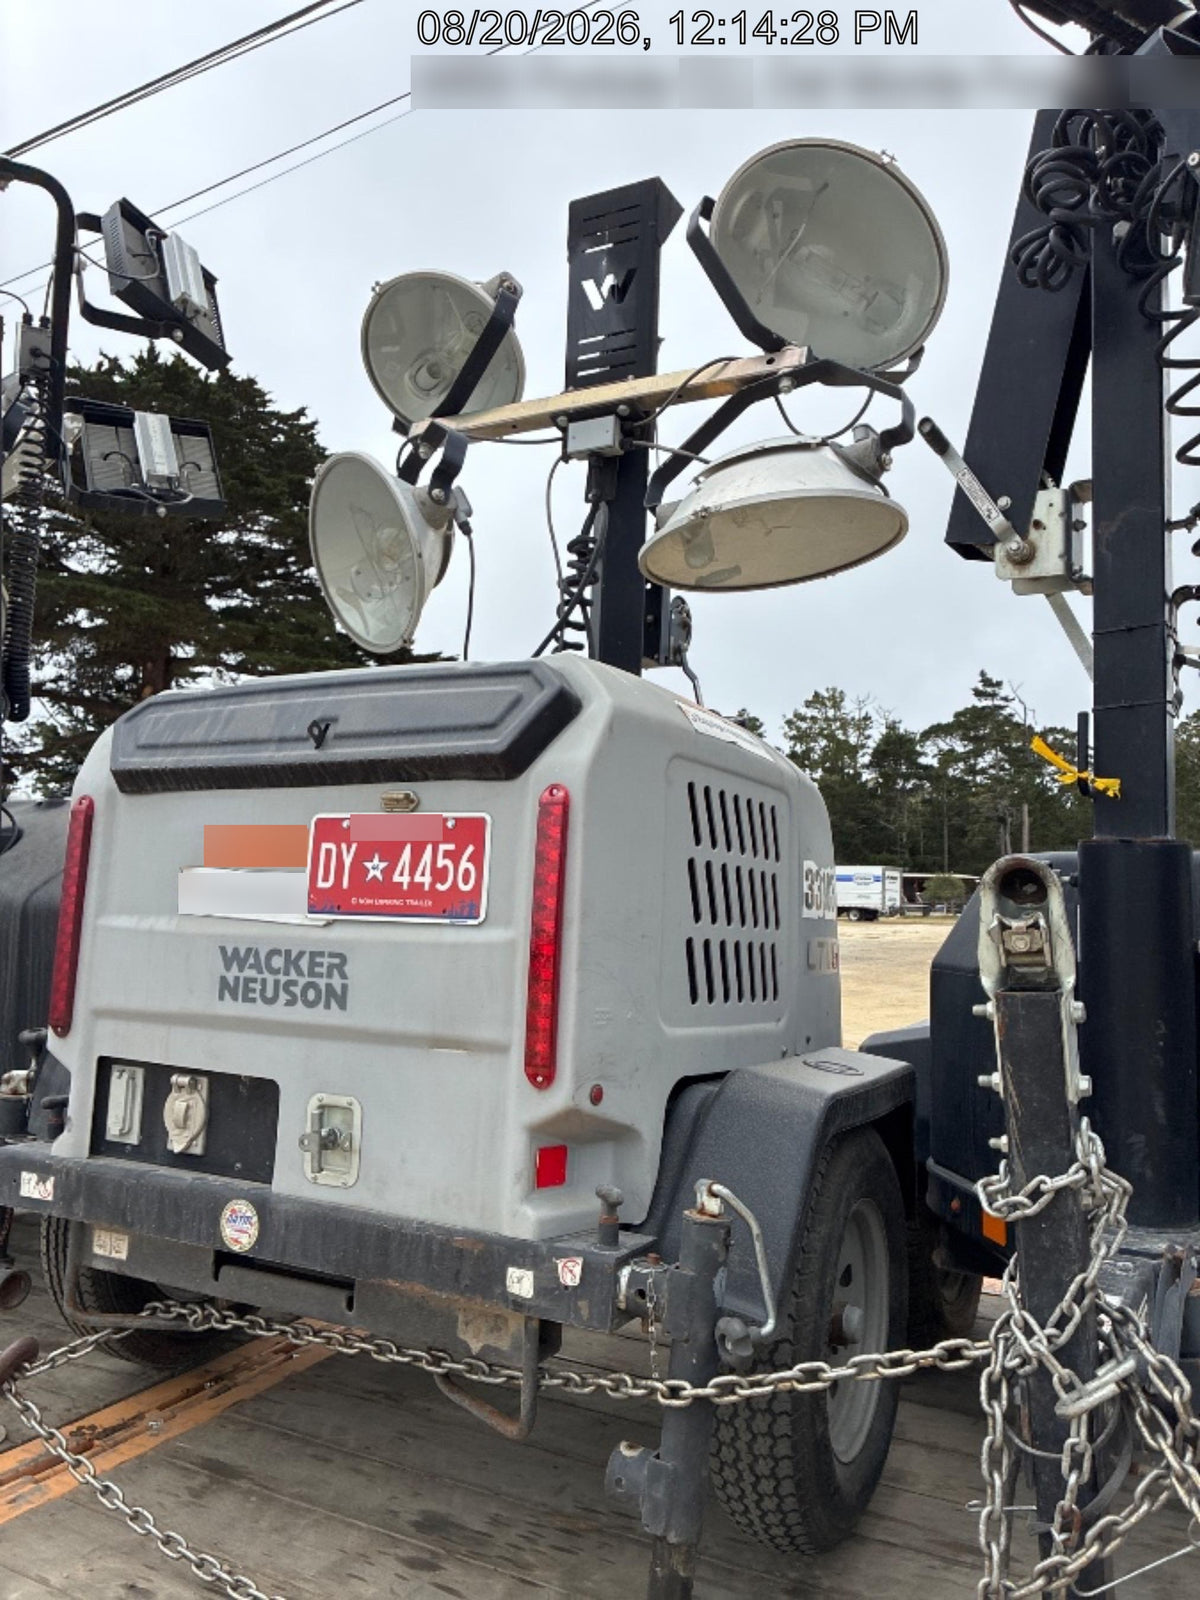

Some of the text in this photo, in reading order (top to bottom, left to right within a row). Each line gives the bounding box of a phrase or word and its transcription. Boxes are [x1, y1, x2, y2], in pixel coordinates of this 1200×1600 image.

[317, 842, 478, 892] DY 4456
[218, 945, 349, 981] WACKER
[218, 976, 348, 1011] NEUSON
